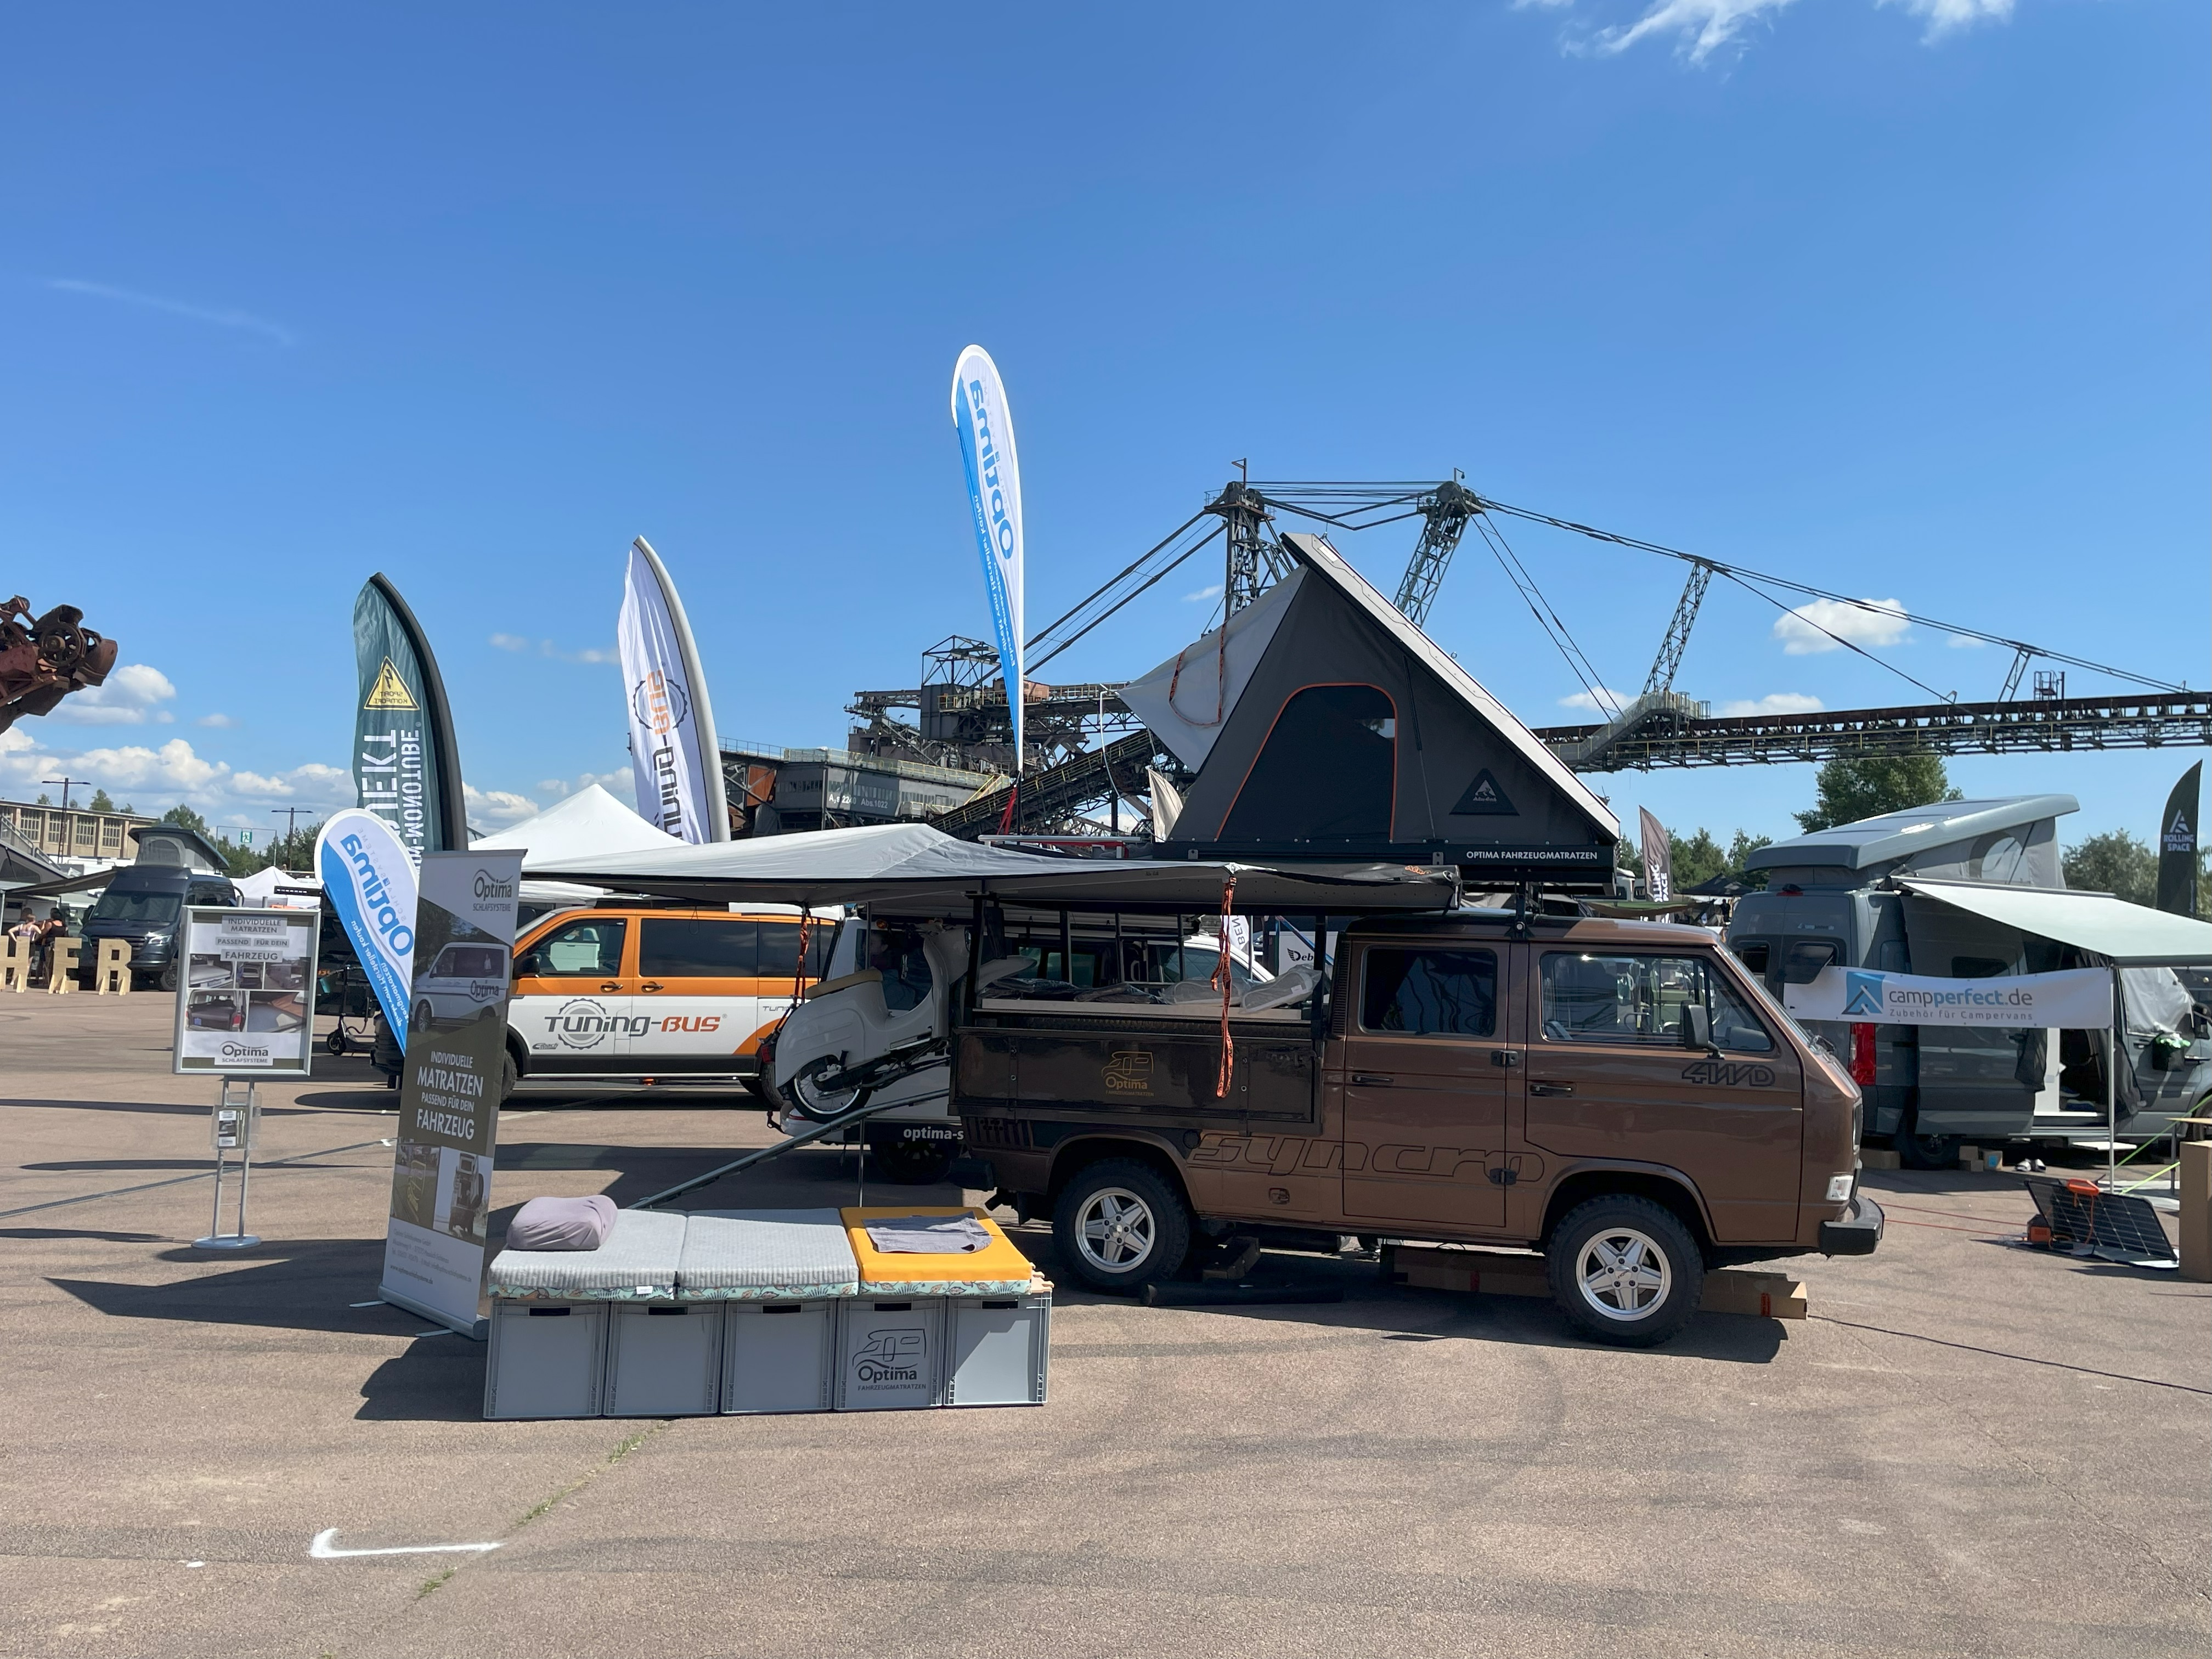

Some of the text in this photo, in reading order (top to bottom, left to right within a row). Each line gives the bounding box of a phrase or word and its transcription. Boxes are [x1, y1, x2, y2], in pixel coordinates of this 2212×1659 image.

[2163, 834, 2194, 843] ROLLING
[2168, 843, 2190, 851] SPACE
[1466, 851, 1598, 860] OPTIMA FAHRZEUGMATRATZEN
[474, 876, 512, 901] Optima
[1660, 872, 1669, 901] PACE
[472, 903, 511, 912] SCHLAFSYSTEME
[228, 917, 281, 927] INDIVIDUELLE
[230, 925, 277, 933] MATRATZEN
[225, 951, 278, 960] FAHRZEUG
[1291, 950, 1313, 961] Deb
[470, 980, 499, 998] Optima
[1889, 988, 2033, 1007] campperfect.de
[1890, 1009, 2032, 1020] Zubehör für Campervans
[222, 1045, 269, 1057] Optima
[431, 1051, 473, 1068] INDIVIDUELLE
[417, 1066, 484, 1097] MATRATZEN
[1681, 1062, 1775, 1087] 4WD
[1105, 1076, 1148, 1090] Optima
[421, 1092, 475, 1113] PASSEND FÜR DEIN
[416, 1108, 475, 1140] FAHRZEUG
[903, 1126, 964, 1141] optima-s
[1193, 1132, 1544, 1182] syncro
[858, 1365, 917, 1384] Optima
